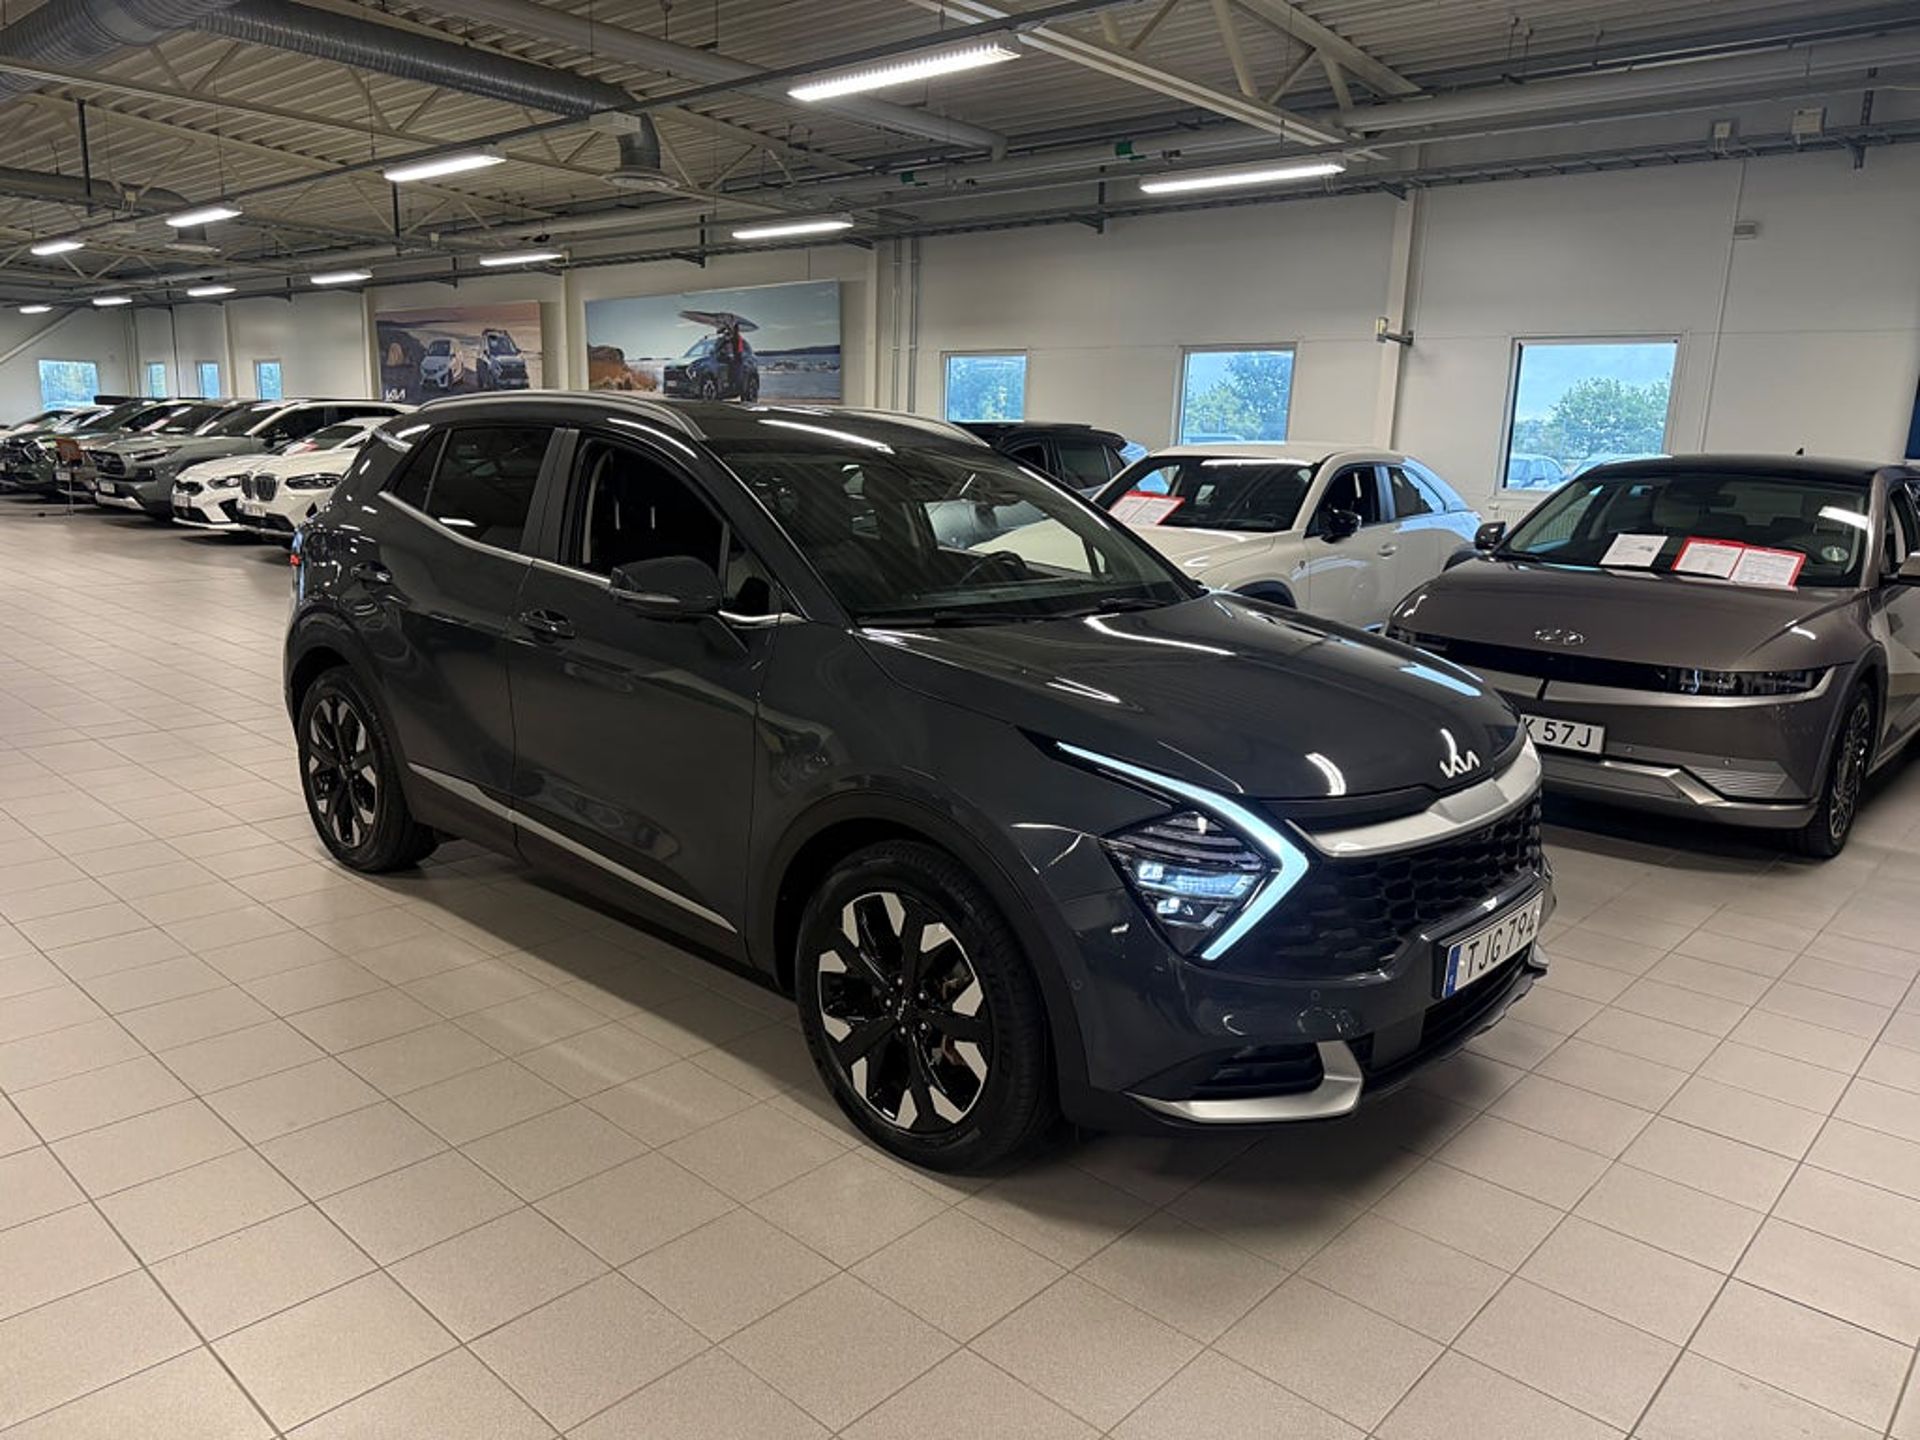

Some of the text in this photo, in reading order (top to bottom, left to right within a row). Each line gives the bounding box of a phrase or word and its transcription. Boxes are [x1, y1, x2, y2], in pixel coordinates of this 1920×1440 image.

[1542, 721, 1593, 748] 57J
[1468, 904, 1536, 979] TJG 794
